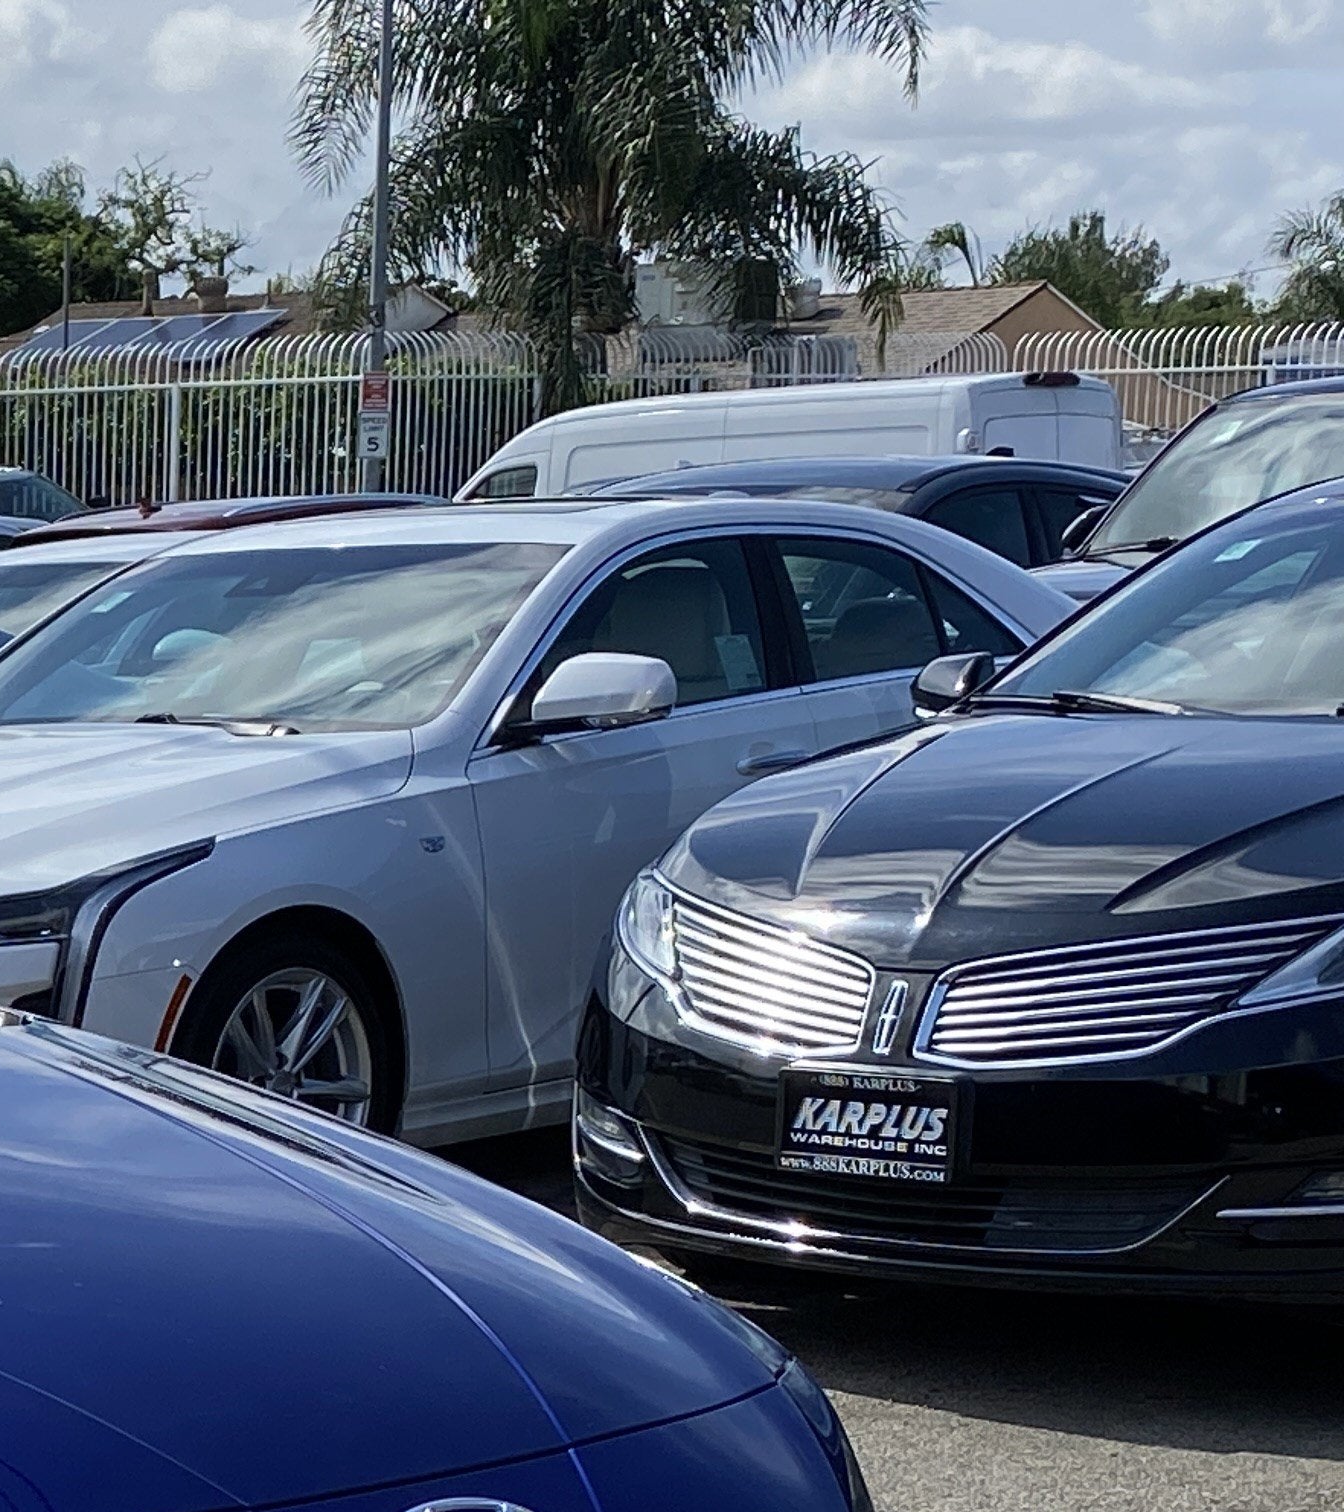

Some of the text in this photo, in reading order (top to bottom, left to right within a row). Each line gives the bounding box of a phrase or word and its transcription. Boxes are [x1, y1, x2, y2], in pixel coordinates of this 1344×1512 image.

[367, 436, 379, 452] 5
[853, 1077, 916, 1092] KARPLUS
[793, 1097, 948, 1140] KARPLUS
[790, 1132, 947, 1156] WAREHOUSE INC
